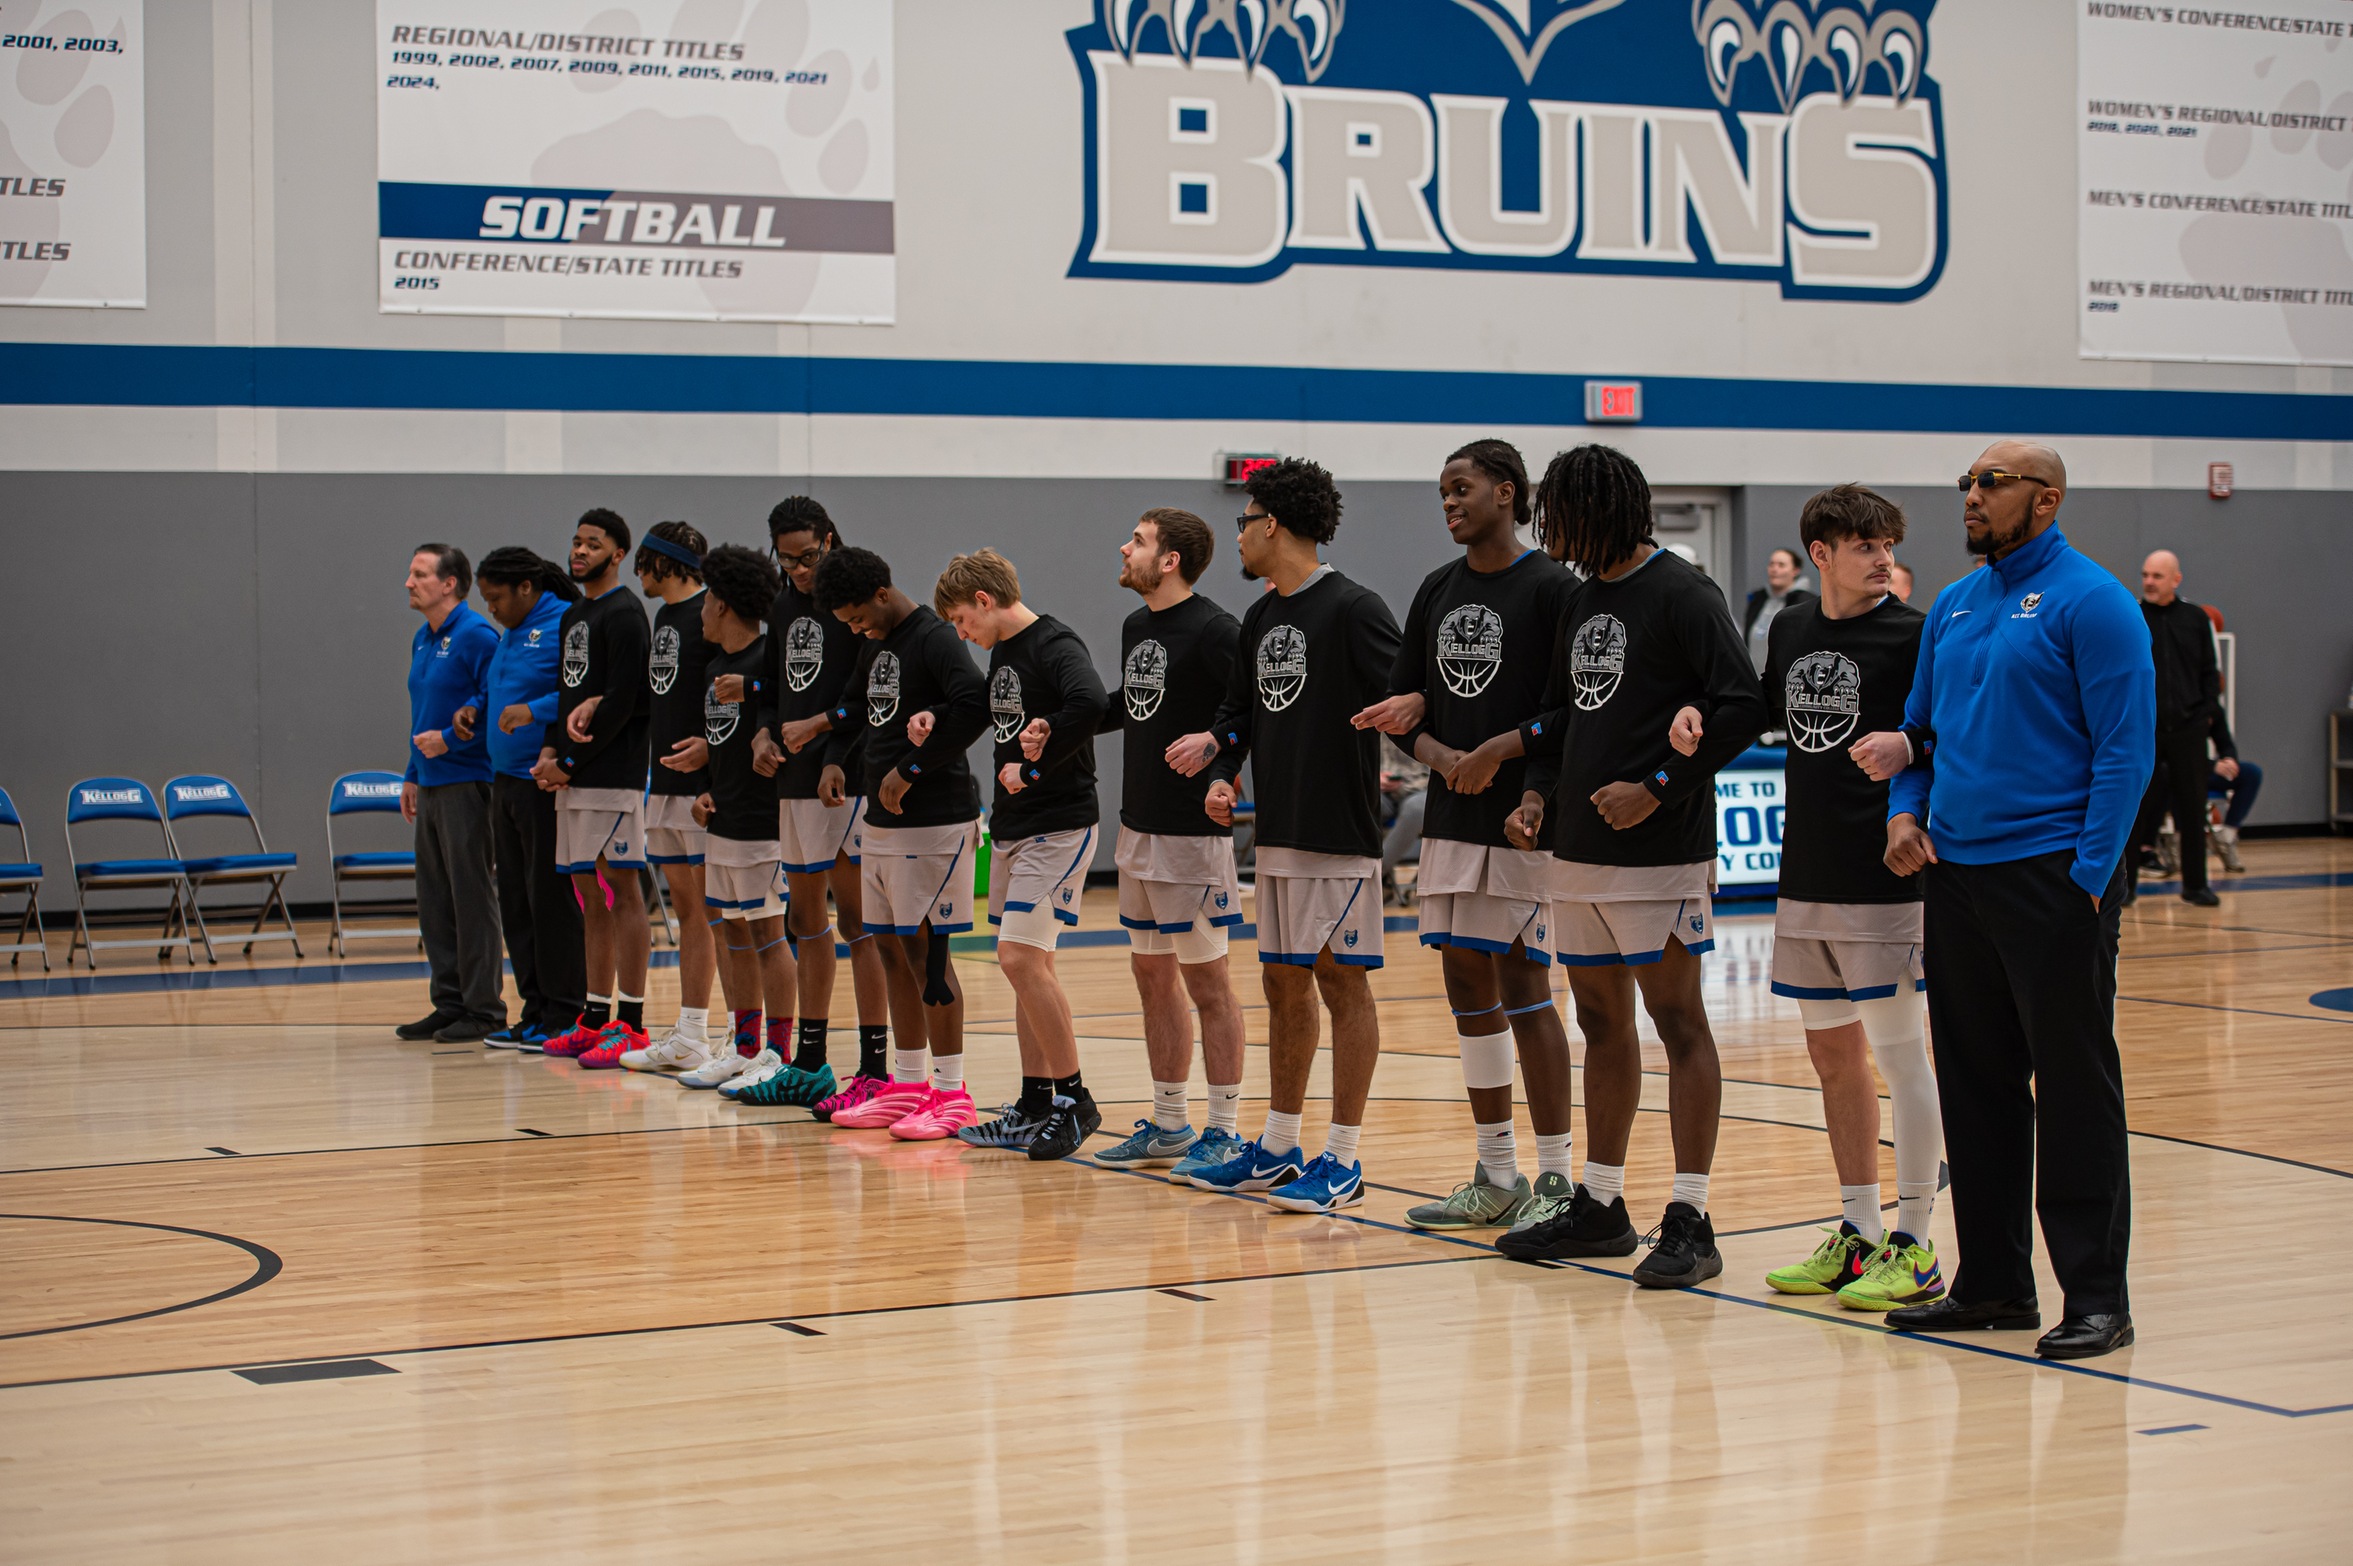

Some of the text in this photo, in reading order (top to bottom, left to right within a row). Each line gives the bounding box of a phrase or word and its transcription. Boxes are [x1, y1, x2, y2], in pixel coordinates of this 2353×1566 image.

[2177, 9, 2344, 37] CONFERENCE/STATE
[2, 34, 123, 55] 2001, 2003,
[391, 25, 745, 60] REGIONAL/DISTRICT TITLES
[393, 52, 828, 85] 1999, 2002, 2007, 2009, 2011, 2015, 2019, 2021
[386, 75, 440, 90] 2024,
[2177, 106, 2346, 132] REGIONAL/DISTRICT
[1089, 49, 1938, 290] BRUINS
[2148, 193, 2317, 217] CONFERENCE/STATE
[479, 195, 785, 247] SOFTBALL
[394, 249, 743, 279] CONFERENCE/STATE TITLES
[394, 277, 440, 291] 2015
[2149, 283, 2320, 305] REGIONAL/DISTRICT
[1601, 386, 1636, 417] EXIT
[1786, 689, 1857, 712] KELLOGG
[83, 789, 141, 803] KELLOGG
[1750, 782, 1776, 798] TO
